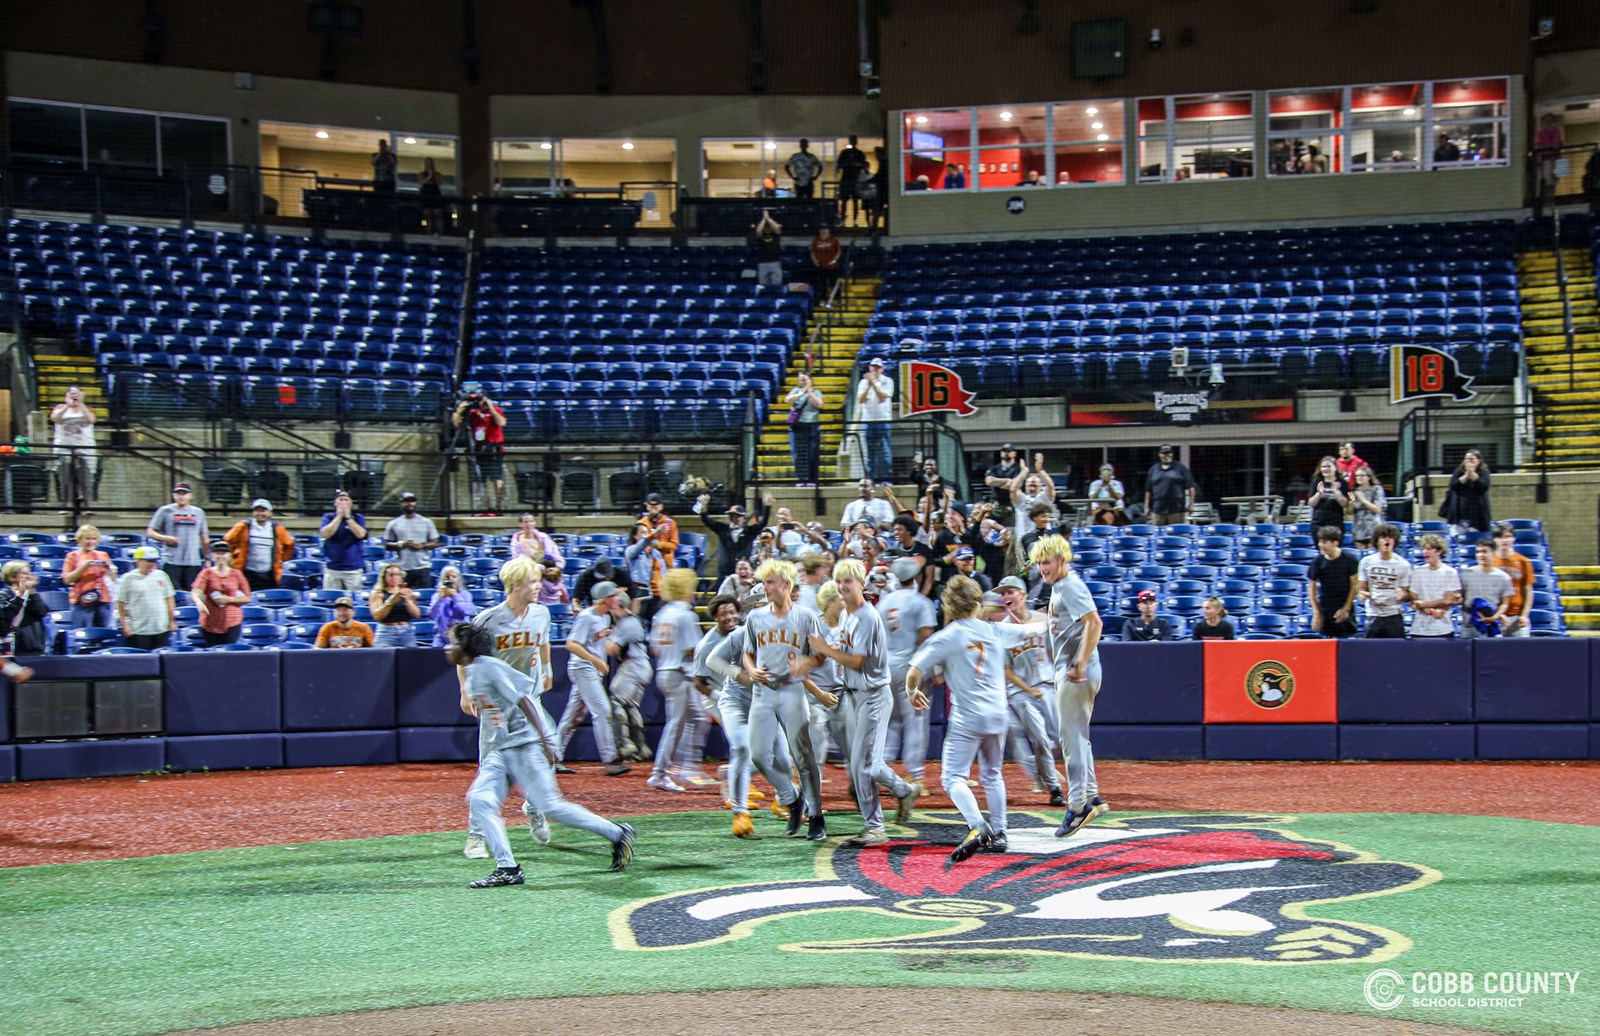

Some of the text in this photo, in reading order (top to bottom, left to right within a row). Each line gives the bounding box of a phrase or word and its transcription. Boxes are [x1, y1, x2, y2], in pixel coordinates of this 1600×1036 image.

[914, 371, 950, 407] 16
[1406, 354, 1444, 392] 18
[757, 629, 801, 650] KELL
[965, 641, 987, 676] 7
